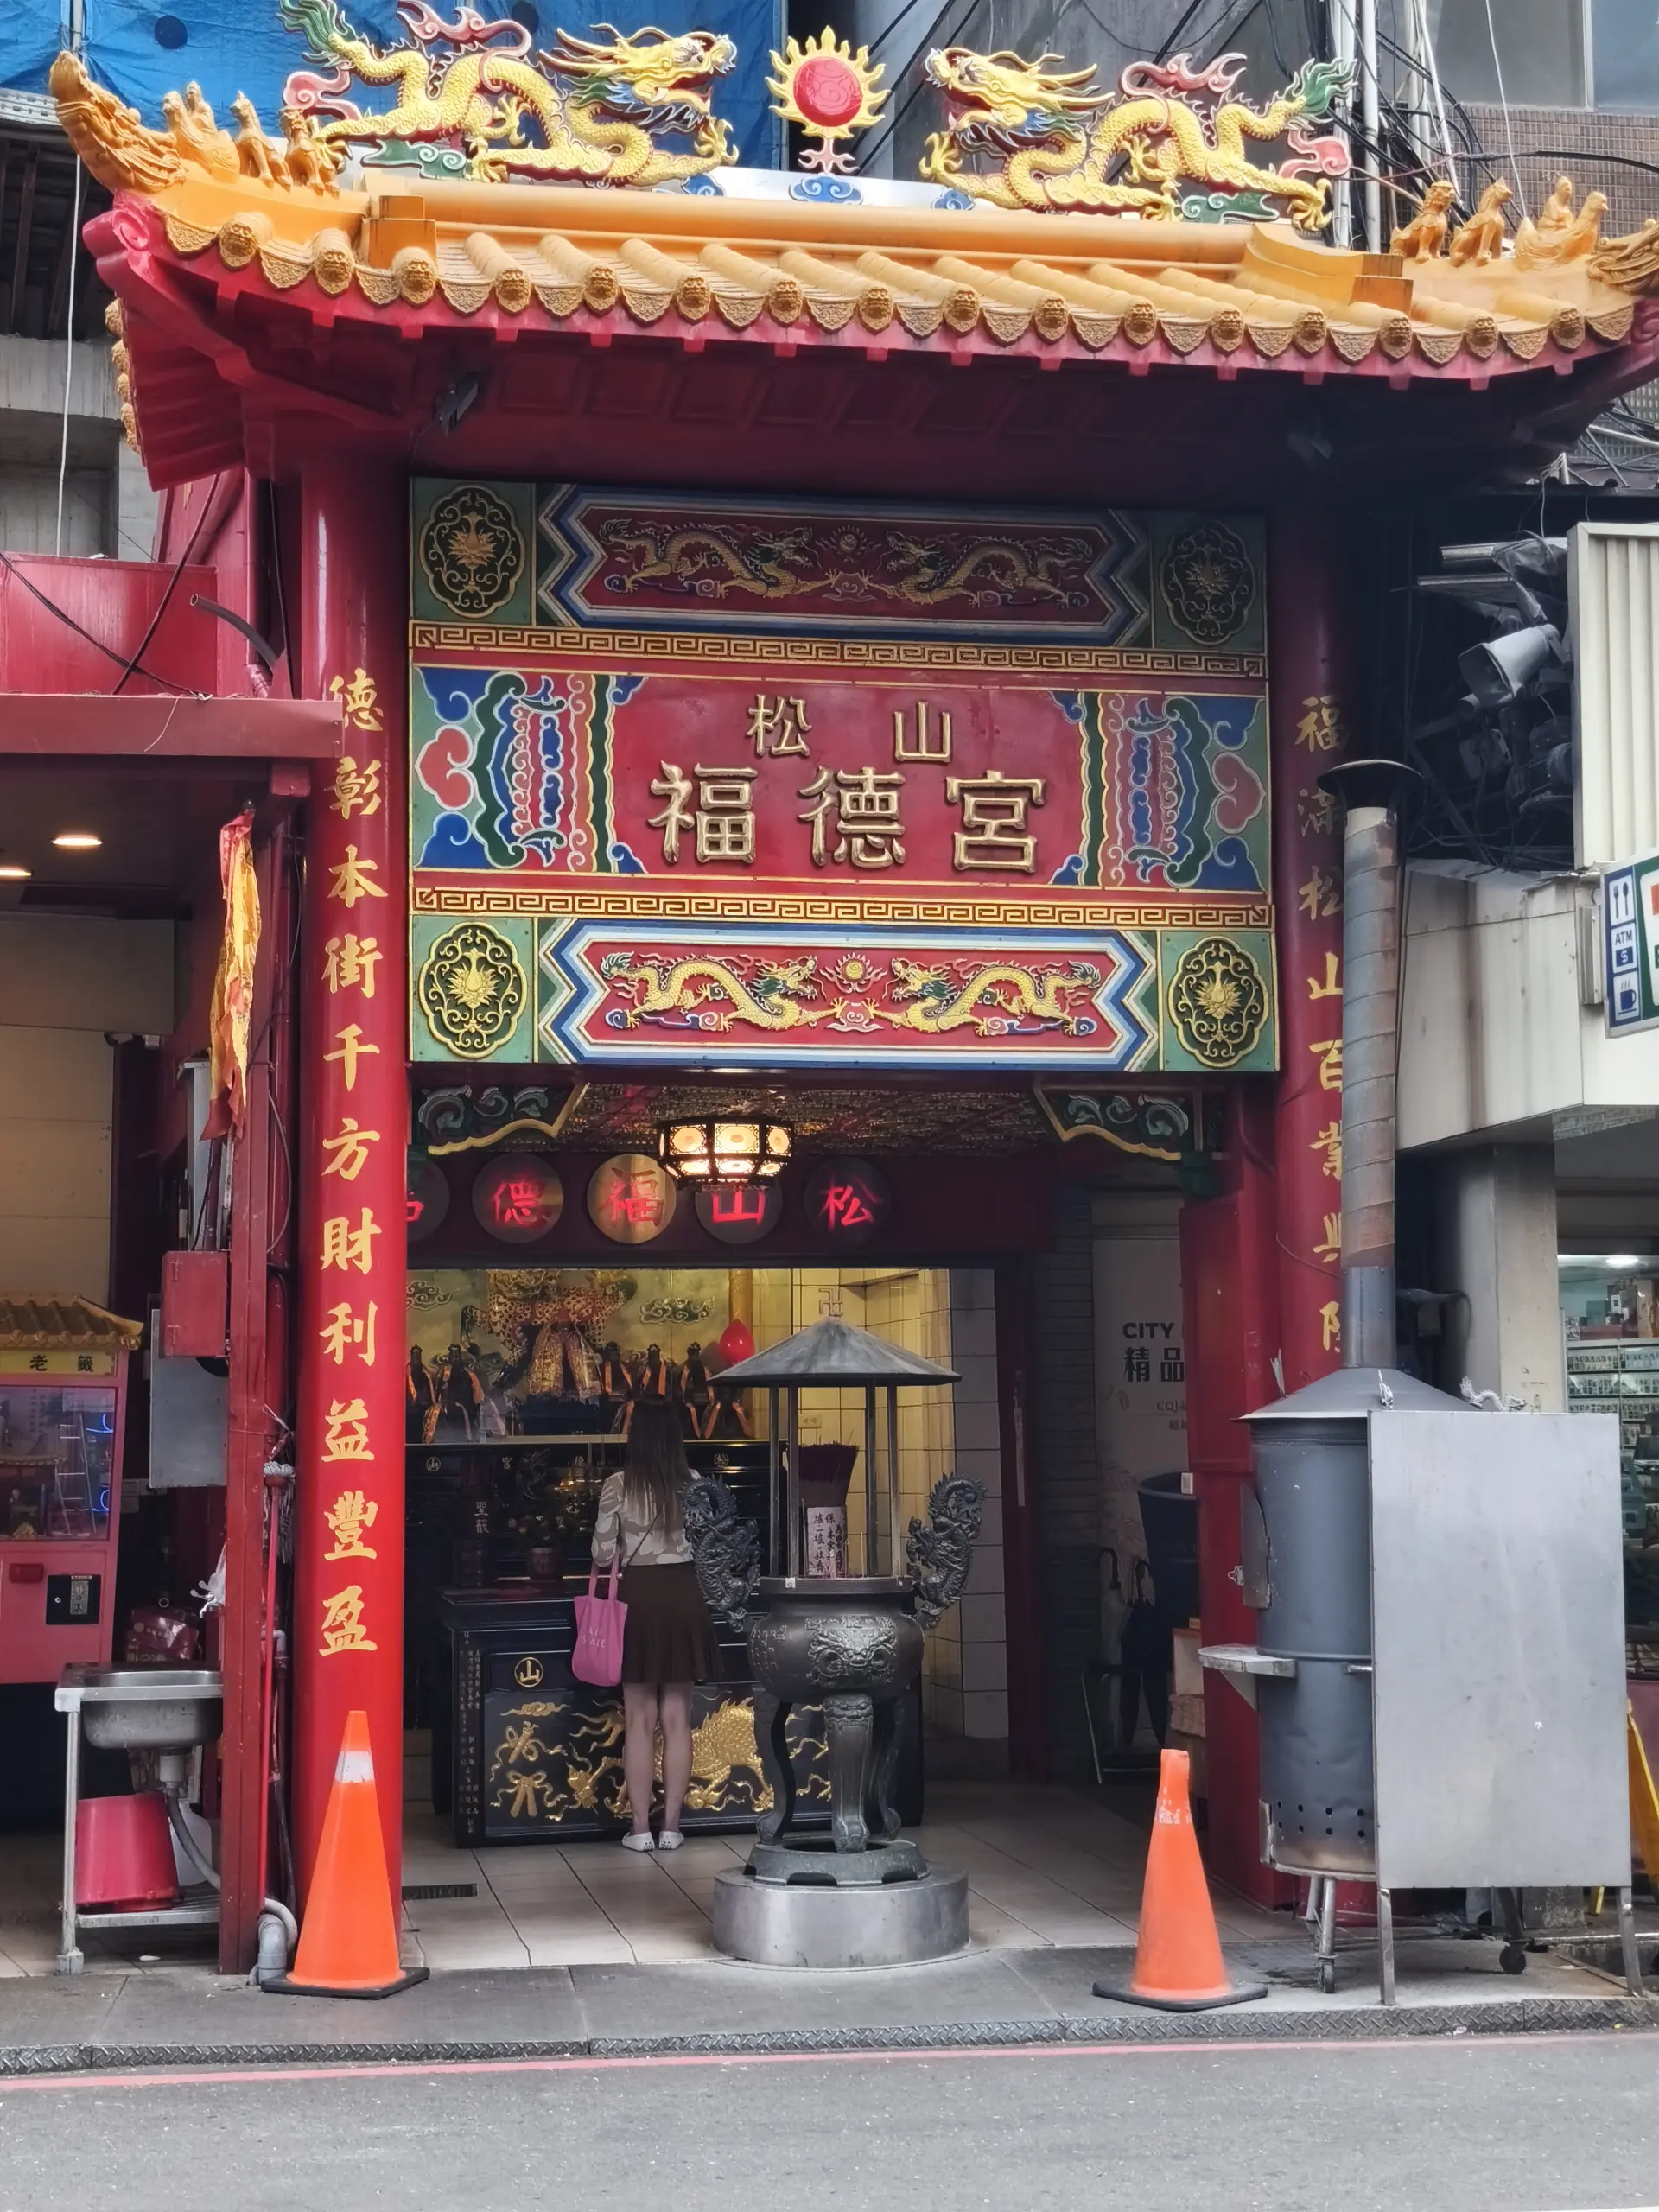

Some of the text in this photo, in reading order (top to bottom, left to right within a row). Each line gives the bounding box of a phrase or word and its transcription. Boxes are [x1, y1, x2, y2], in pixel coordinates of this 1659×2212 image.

[745, 694, 954, 764] 松山
[647, 760, 1047, 873] 福德宮
[1615, 930, 1632, 944] ATM
[320, 667, 388, 1657] 德彰本街千方財利益豐盈
[1122, 1322, 1174, 1339] CITY
[1123, 1346, 1185, 1382] 精品
[520, 1659, 540, 1682] 山
